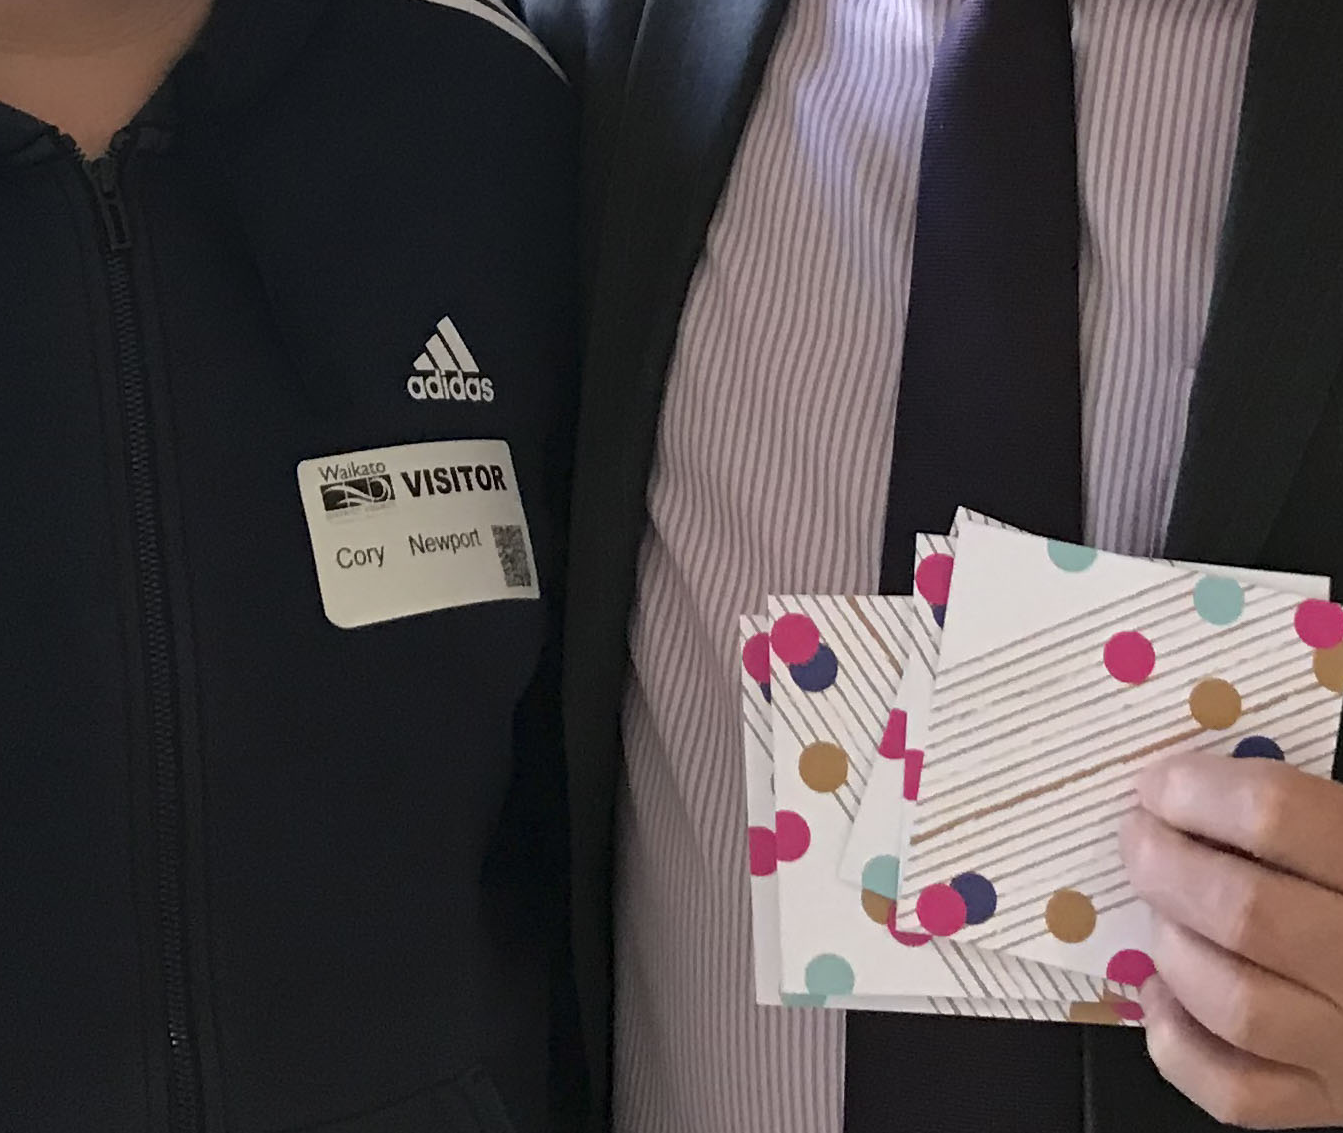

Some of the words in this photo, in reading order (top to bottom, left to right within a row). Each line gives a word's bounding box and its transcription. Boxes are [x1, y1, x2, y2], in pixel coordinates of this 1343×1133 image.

[408, 370, 495, 402] adidas
[318, 461, 386, 483] Waikato
[401, 465, 508, 497] VISITOR
[336, 545, 386, 569] Cory
[409, 528, 483, 556] Newport
